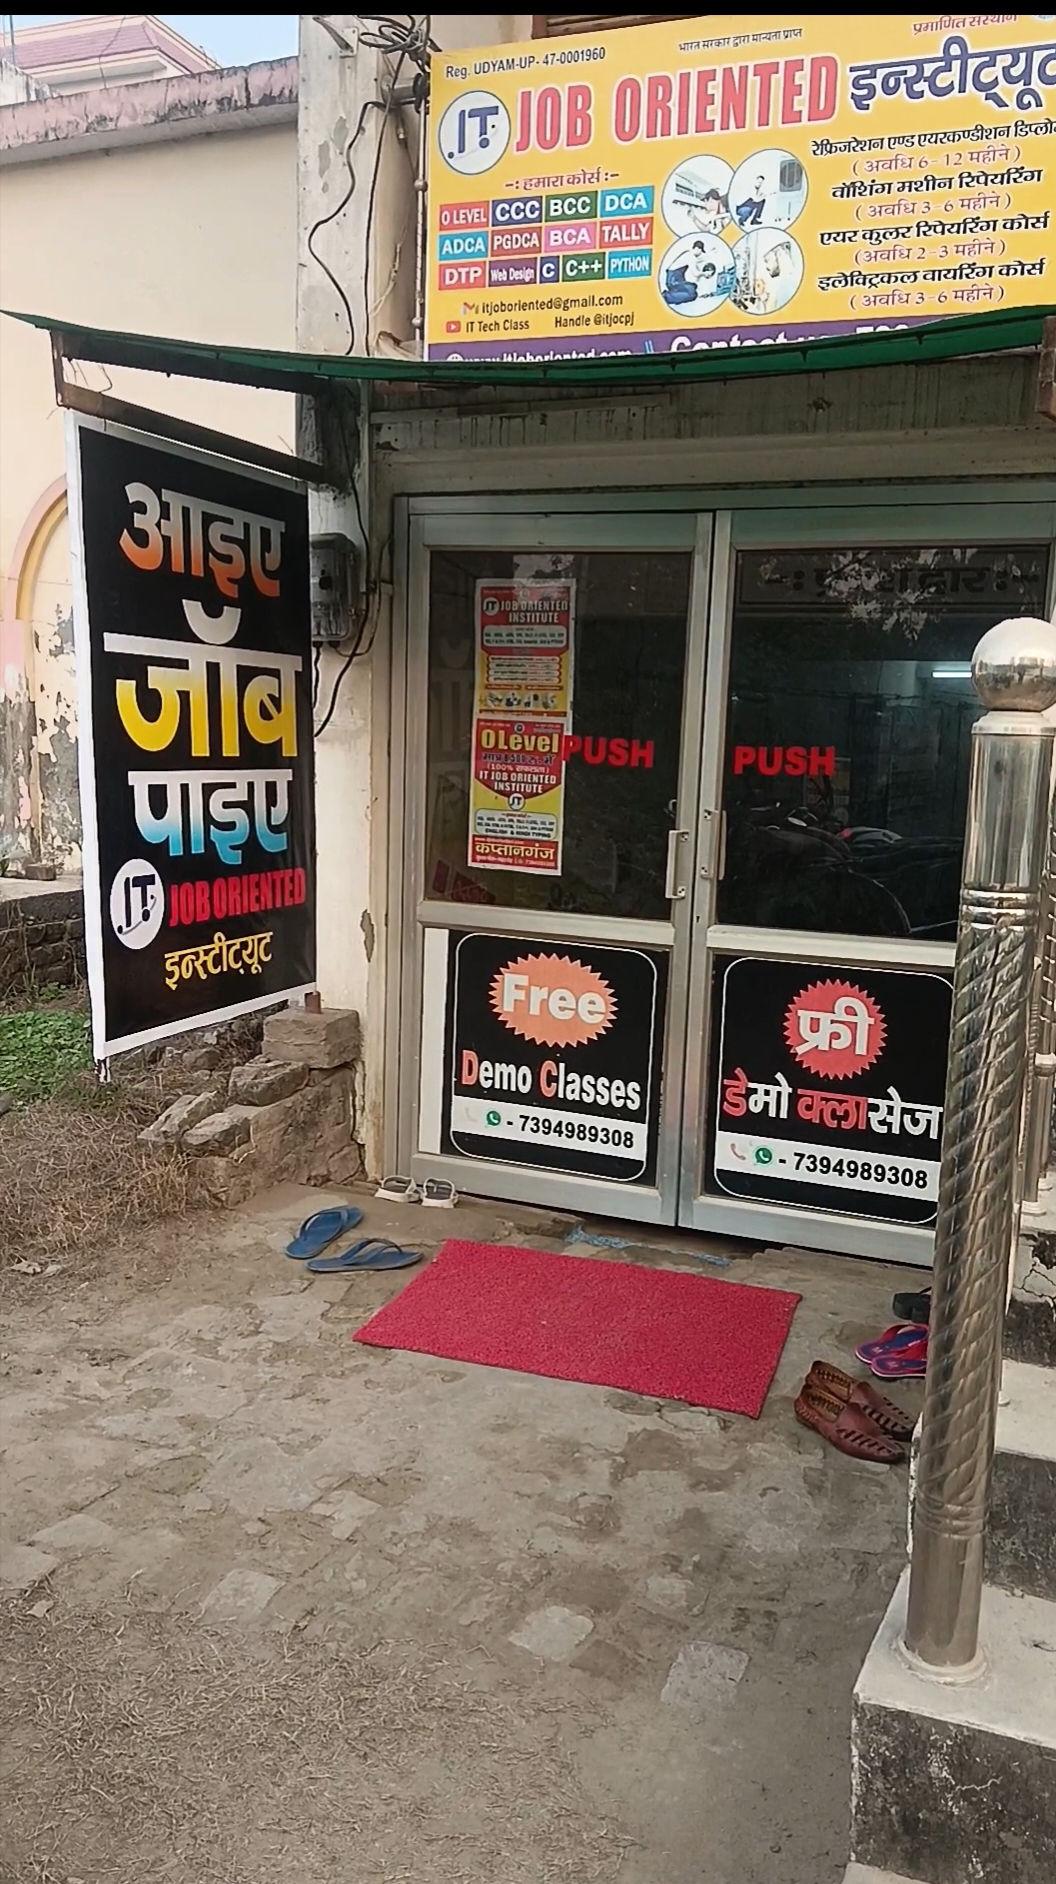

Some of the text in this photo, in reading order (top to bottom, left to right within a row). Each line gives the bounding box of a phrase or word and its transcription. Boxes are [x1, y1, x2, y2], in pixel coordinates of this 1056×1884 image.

[913, 15, 967, 35] प्रमाणित
[679, 28, 803, 51] भारत सरकार द्वारा मान्यता प्राप्त
[446, 65, 470, 79] Reg.
[542, 46, 606, 66] 47-0001960
[516, 84, 593, 152] JOB
[614, 56, 838, 142] ORIENTED
[811, 137, 884, 156] रेफ्रिजरेशन
[888, 134, 916, 149] एण्ड
[918, 123, 1011, 147] एयरकण्डीशन
[523, 175, 564, 190] हमारा
[566, 166, 602, 185] कोर्स
[897, 174, 954, 192] मशीन
[958, 166, 1043, 188] रिपेयरिंग
[495, 200, 540, 222] CCC
[549, 196, 591, 217] BCC
[604, 192, 647, 212] DCA
[453, 208, 487, 225] LEVEL
[549, 227, 592, 247] BCA
[602, 222, 650, 243] TALLY
[819, 230, 857, 246] एयर
[916, 216, 998, 238] रिपेयरिंग
[1002, 210, 1051, 231] कोर्स
[441, 236, 486, 255] ADCA
[493, 232, 540, 251] PGDCA
[490, 266, 535, 282] Web Design
[541, 262, 555, 278] C
[565, 259, 603, 276] C++
[610, 255, 650, 273] PYTHON
[922, 262, 993, 283] वायरिंग
[998, 258, 1046, 277] कोर्स
[444, 266, 482, 285] DTP
[482, 294, 623, 316] itjoboriented@gmail.com
[466, 321, 475, 333] IT
[478, 320, 500, 333] Tech
[503, 318, 530, 331] Class
[555, 314, 591, 328] Handle
[119, 482, 285, 598] आइए
[500, 600, 520, 611] JOB
[521, 600, 568, 612] ORIENTED
[508, 612, 559, 623] INSTITUTE
[103, 598, 302, 757] जॉब
[481, 729, 559, 753] O Level
[564, 734, 655, 769] PUSH
[732, 746, 836, 776] PUSH
[480, 770, 557, 784] IT JOB ORIENTED
[494, 782, 543, 793] INSTITUTE
[127, 768, 293, 865] पाइए
[475, 842, 555, 860] कप्तानगंज
[169, 881, 210, 927] JOB
[212, 867, 306, 925] ORIENTED
[502, 973, 606, 1024] Free
[795, 996, 875, 1056] फ्री
[461, 1050, 641, 1110] Demo Classes
[723, 1067, 944, 1140] डेमो क्लासेज
[519, 1114, 634, 1149] 7394989308
[793, 1152, 928, 1189] 7394989308
